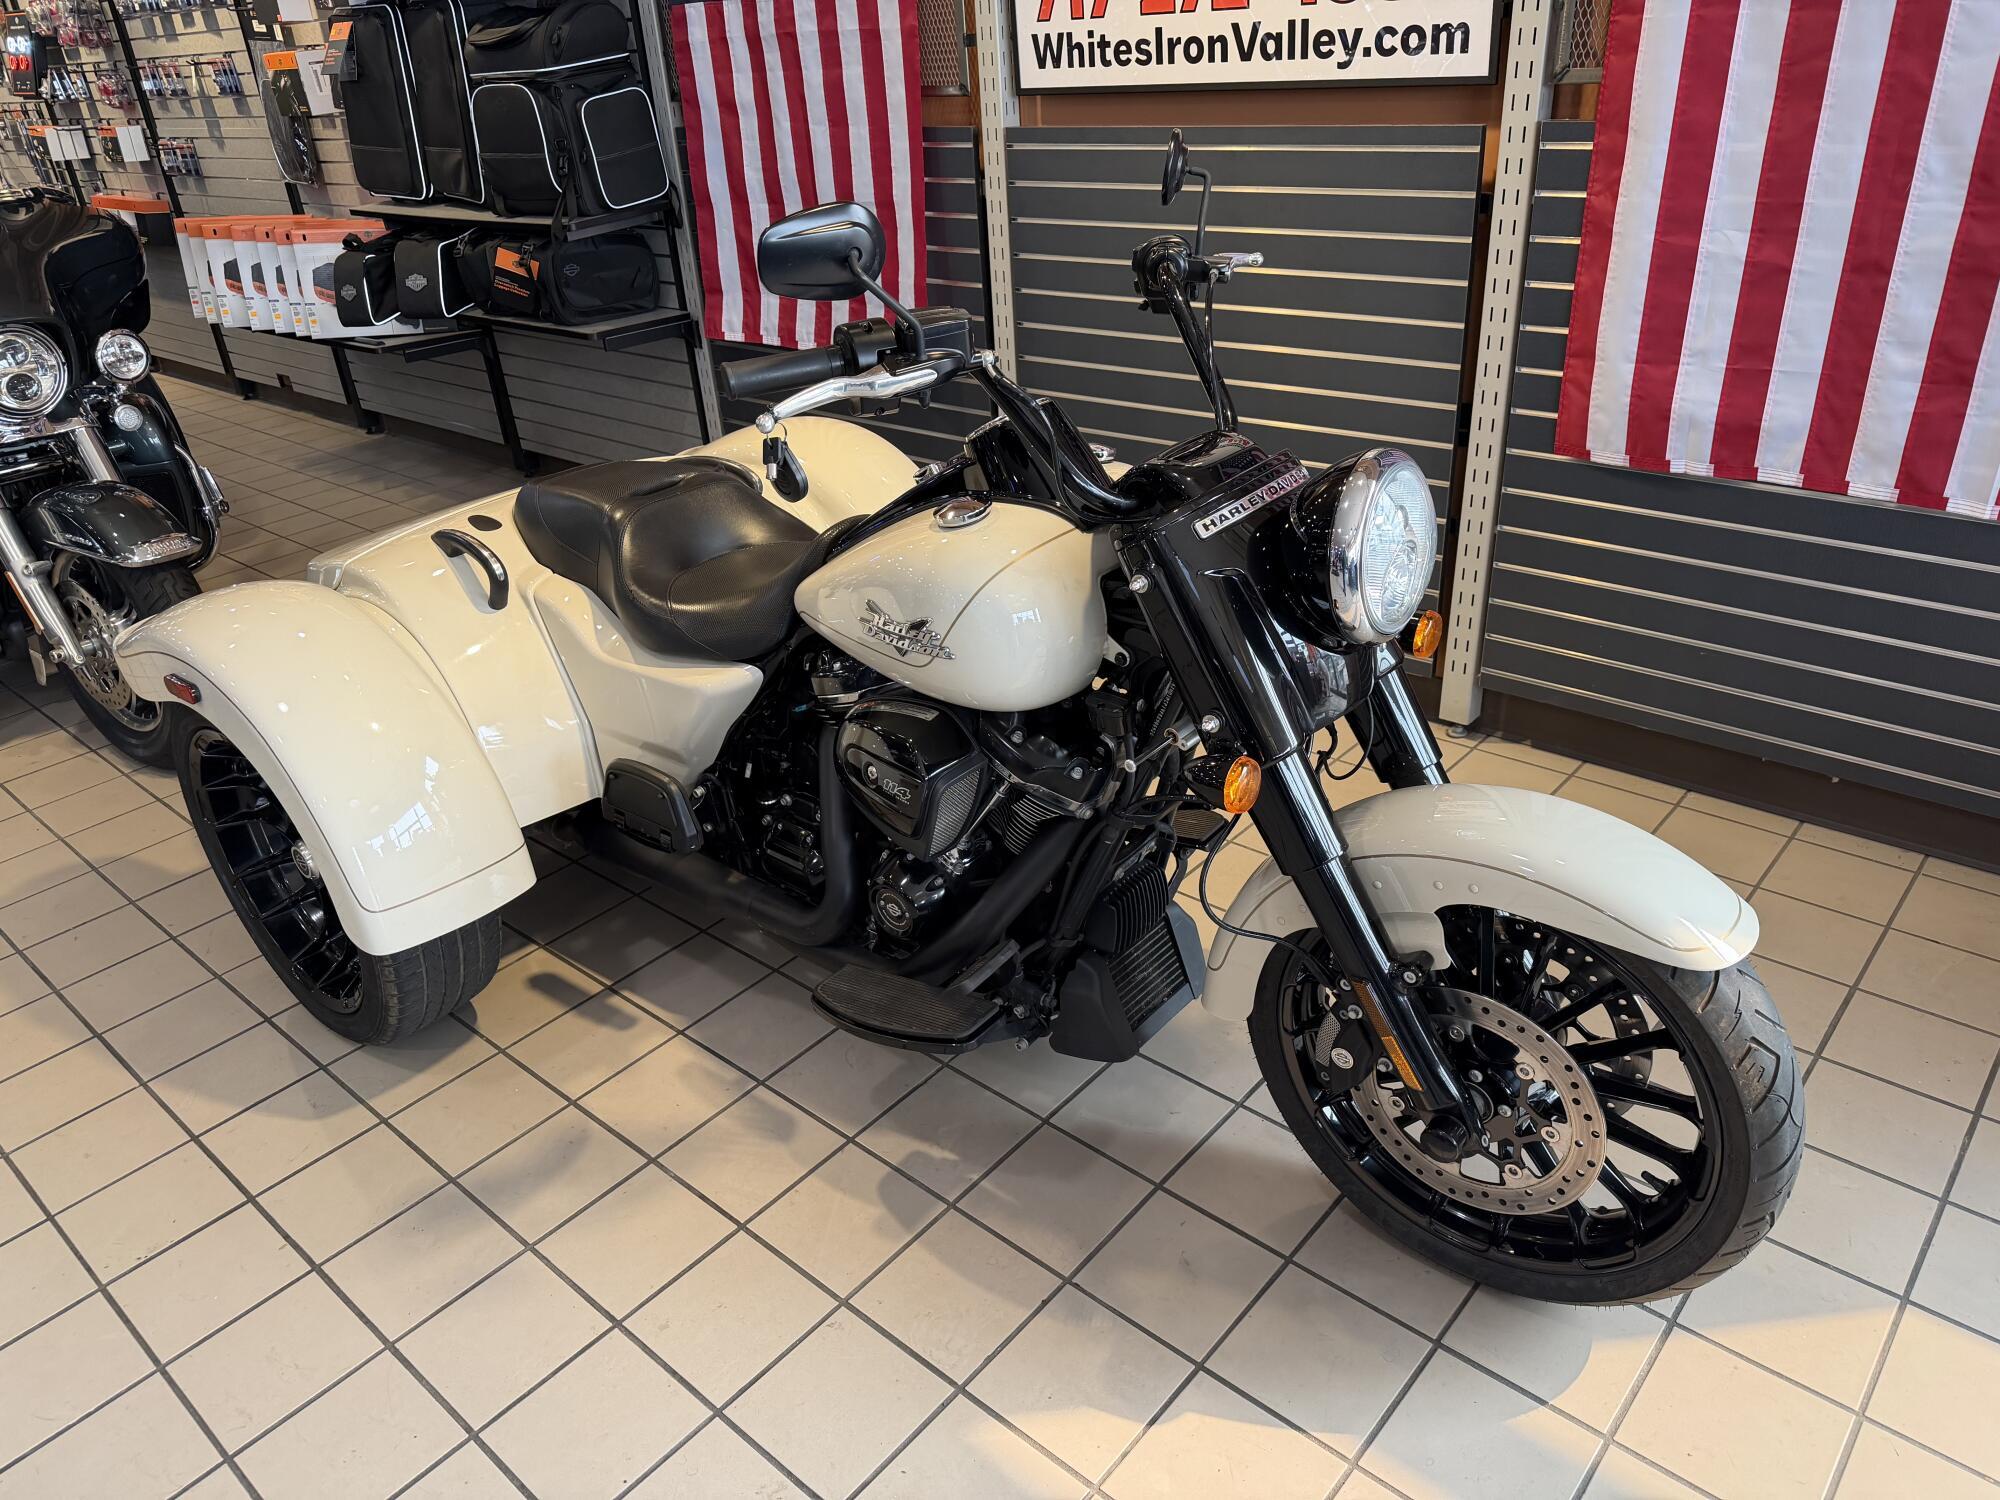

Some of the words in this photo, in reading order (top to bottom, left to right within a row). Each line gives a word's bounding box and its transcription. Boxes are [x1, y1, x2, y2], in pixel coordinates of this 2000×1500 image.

[1031, 19, 1470, 69] WhitesIronValley.com
[1200, 468, 1308, 533] HARLEY-DAVIDSO
[883, 778, 911, 800] 114
